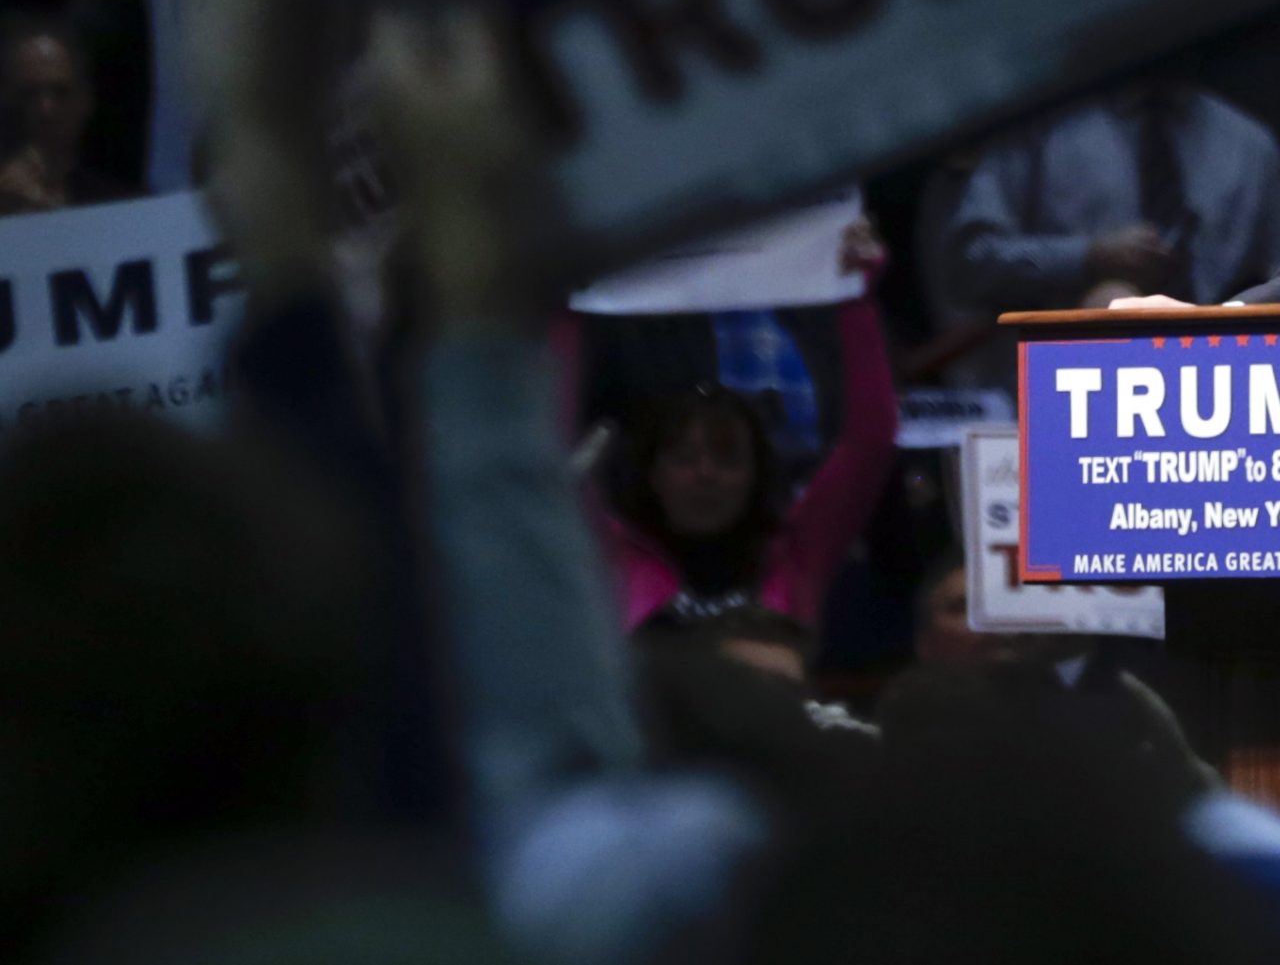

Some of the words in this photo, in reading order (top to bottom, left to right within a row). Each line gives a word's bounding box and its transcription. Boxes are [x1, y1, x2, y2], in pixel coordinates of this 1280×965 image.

[1079, 456, 1132, 484] TEXT
[1245, 456, 1266, 482] to
[1109, 503, 1198, 536] Albany,
[1205, 503, 1258, 528] New
[1074, 554, 1126, 573] MAKE
[1132, 553, 1218, 573] AMERICA
